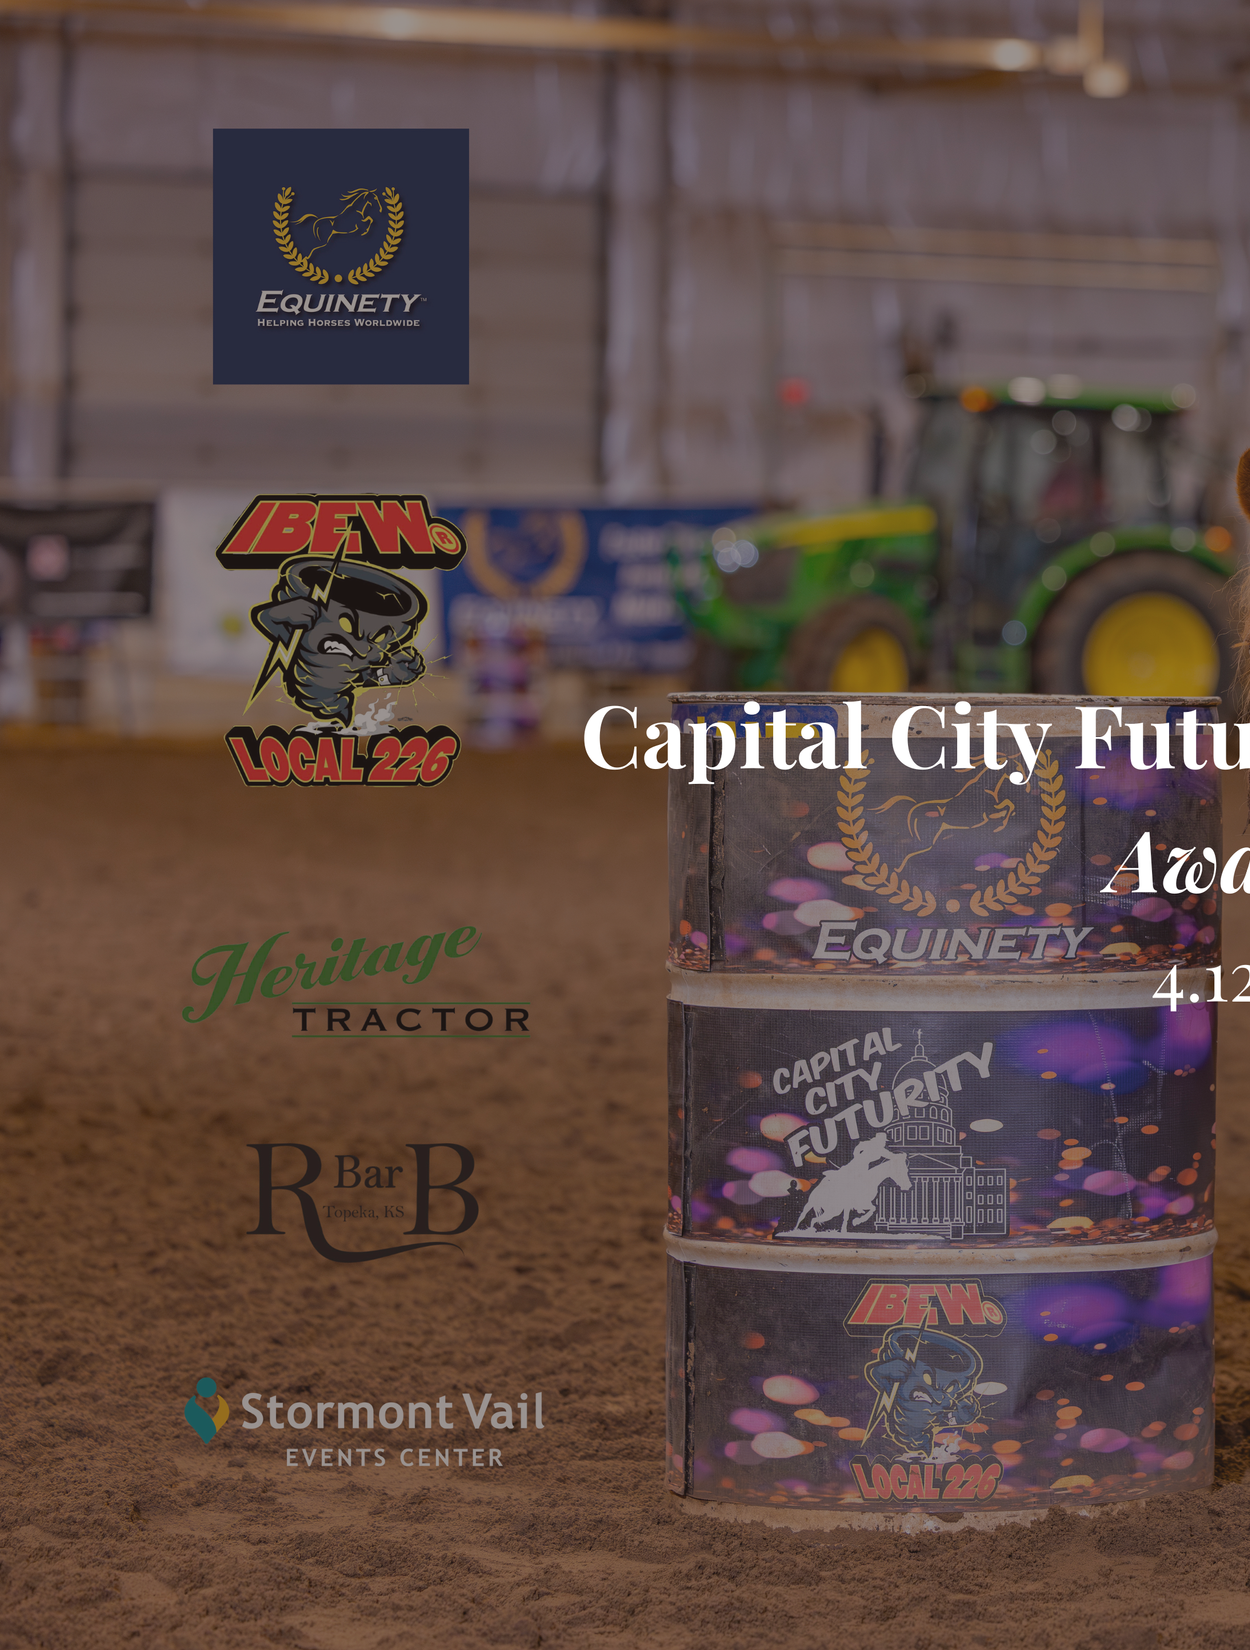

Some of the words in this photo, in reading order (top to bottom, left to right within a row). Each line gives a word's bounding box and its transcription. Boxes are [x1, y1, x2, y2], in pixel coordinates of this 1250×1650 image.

[811, 920, 1094, 964] EQUINETY
[772, 1027, 902, 1095] CAPITAL
[805, 1061, 882, 1116] CITY
[787, 1041, 993, 1168] FUTURITY
[851, 1462, 940, 1500] LOCAL
[941, 1462, 1002, 1500] 226
